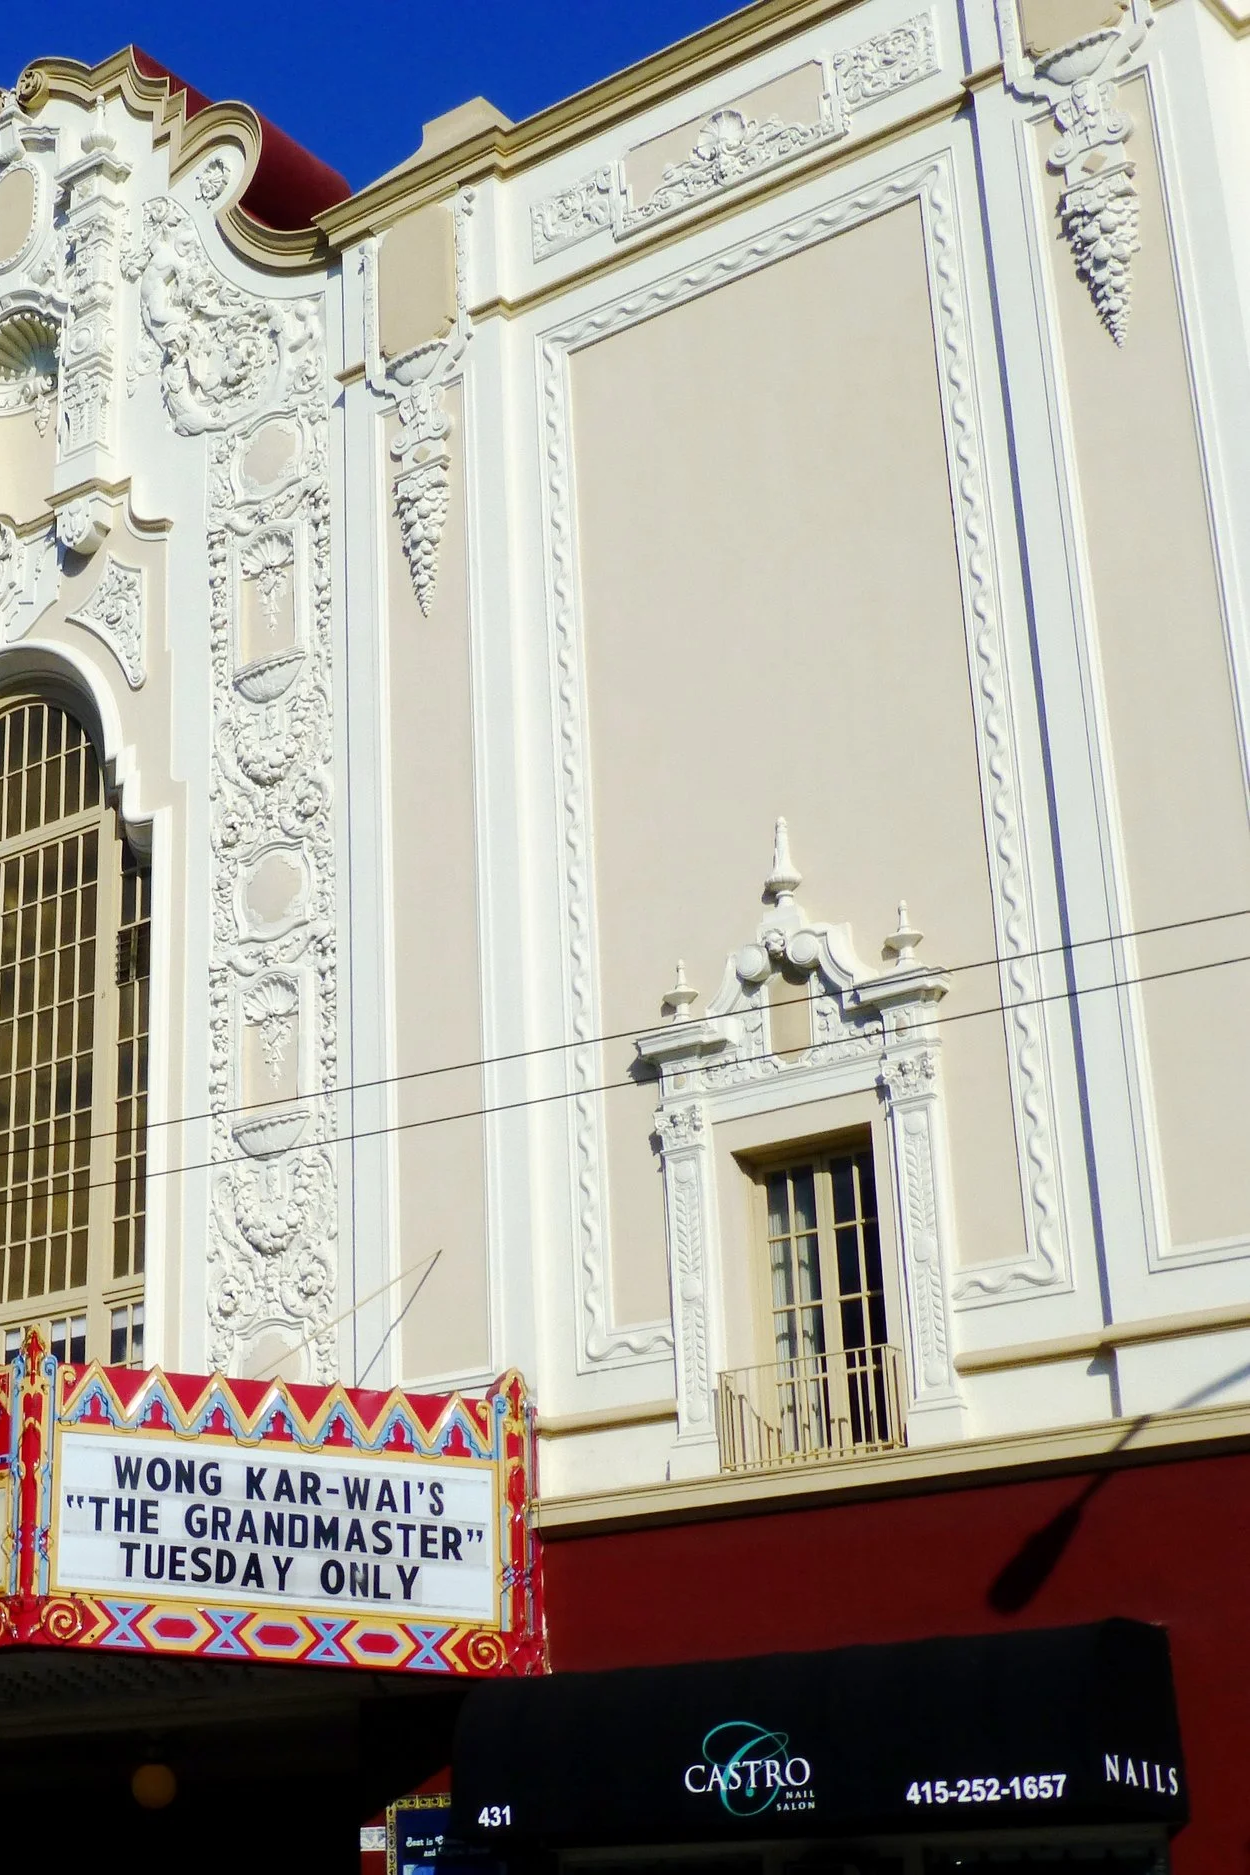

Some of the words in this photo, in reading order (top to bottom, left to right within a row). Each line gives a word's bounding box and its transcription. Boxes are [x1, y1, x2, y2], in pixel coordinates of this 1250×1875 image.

[113, 1455, 223, 1497] WONG
[246, 1466, 445, 1516] KAR-WAI'S
[66, 1495, 160, 1535] "THE
[184, 1503, 485, 1561] GRANDMASTER"
[119, 1541, 294, 1592] TUESDAY
[319, 1558, 421, 1600] ONLY
[684, 1757, 811, 1794] CASTRO
[906, 1774, 1067, 1805] 415-252-1657
[1105, 1753, 1179, 1796] NAILS
[777, 1802, 816, 1811] SALON
[786, 1790, 815, 1799] NAIL
[478, 1805, 511, 1827] 431
